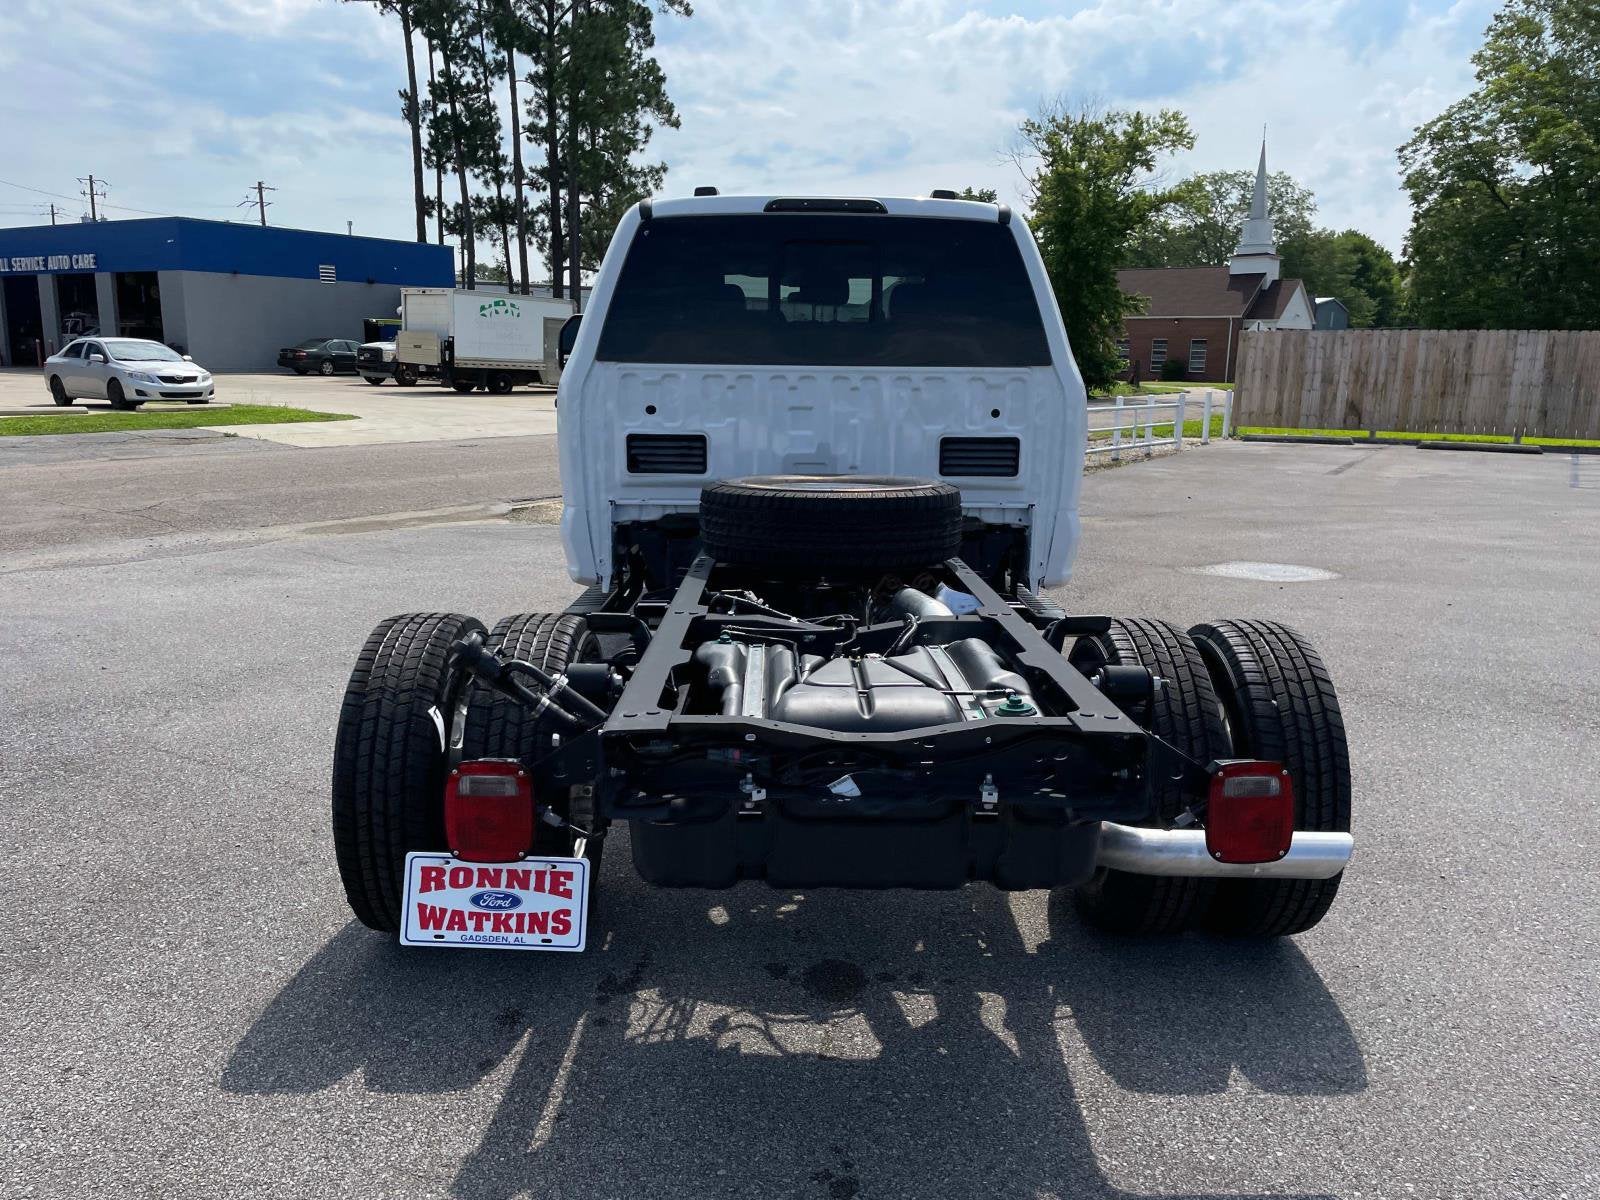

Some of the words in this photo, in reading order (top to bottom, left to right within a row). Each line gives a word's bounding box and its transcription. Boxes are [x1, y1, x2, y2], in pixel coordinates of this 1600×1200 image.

[12, 256, 46, 271] SERVICE
[48, 255, 71, 270] AUTO
[72, 254, 97, 269] CARE
[419, 865, 574, 899] RONNIE
[478, 891, 514, 909] Ford
[417, 902, 572, 936] WATKINS
[460, 934, 511, 944] GADSDEN,
[513, 936, 526, 944] AL
